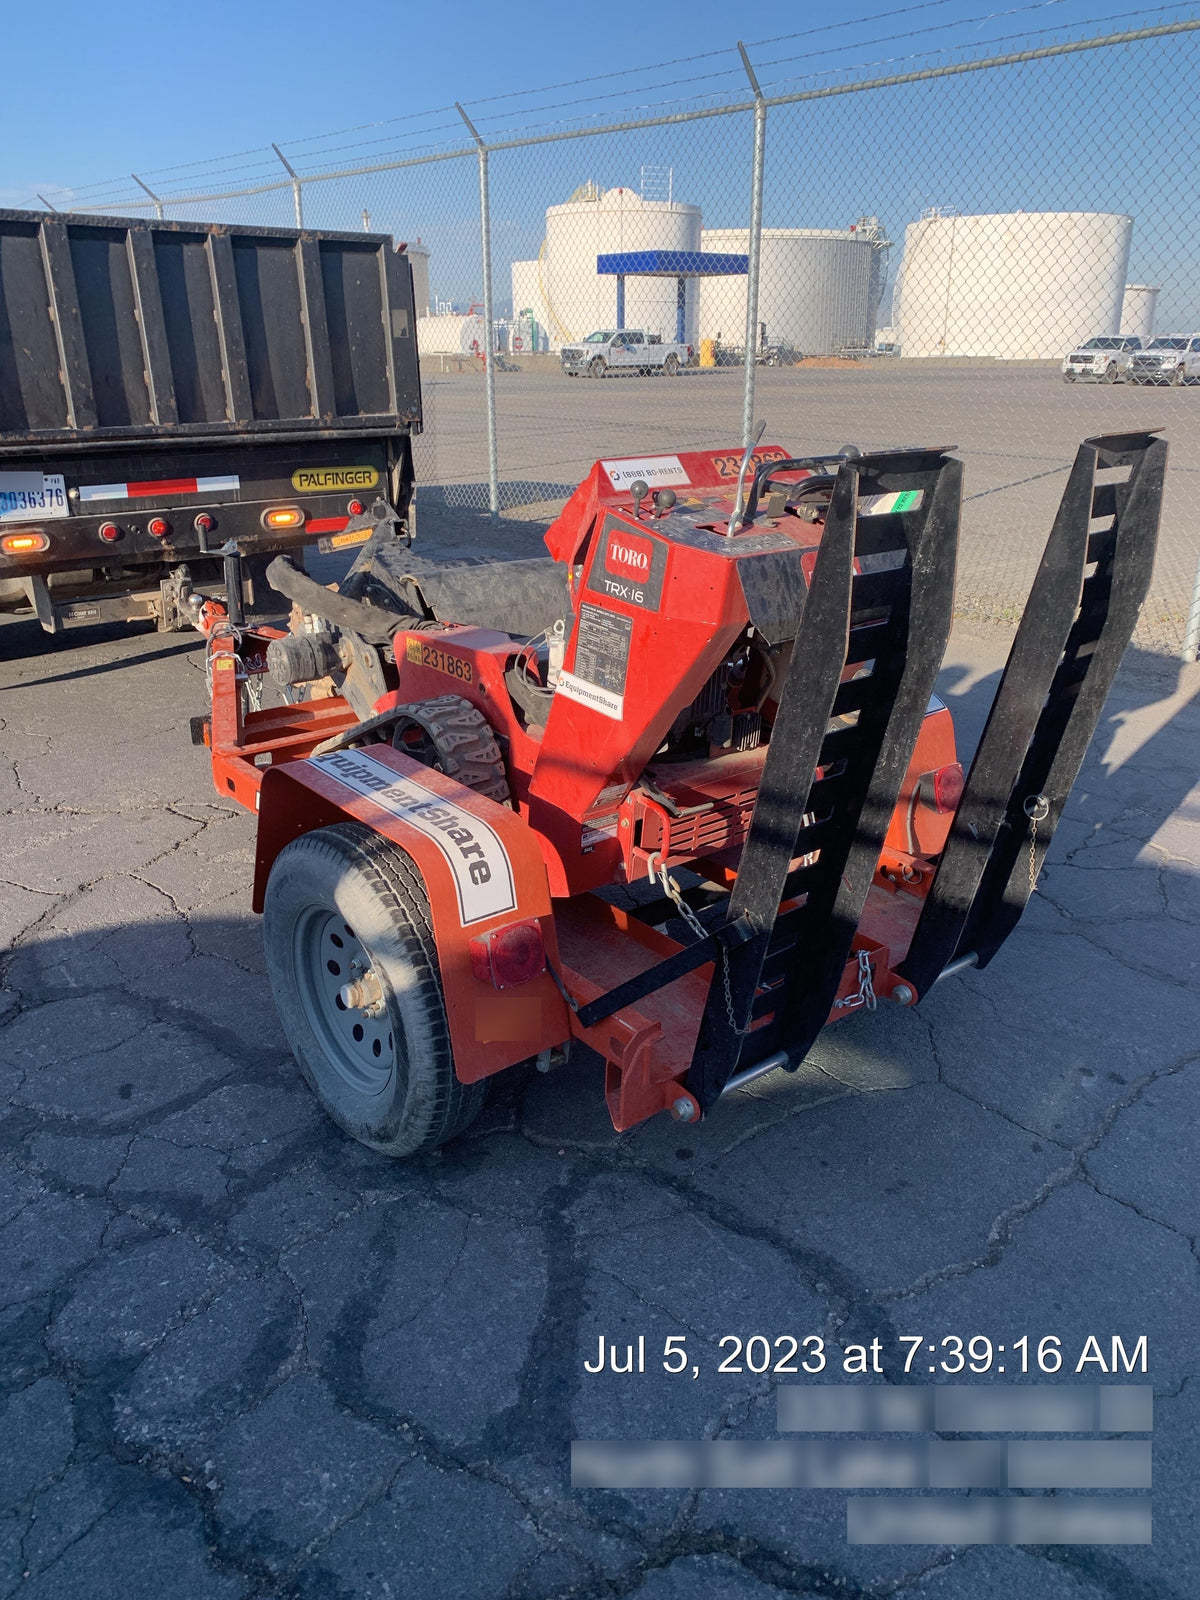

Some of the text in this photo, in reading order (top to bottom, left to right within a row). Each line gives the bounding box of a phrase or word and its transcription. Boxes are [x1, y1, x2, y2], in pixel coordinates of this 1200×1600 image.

[299, 471, 372, 487] PALFINGER
[610, 544, 648, 569] TORO
[423, 646, 472, 682] 231863
[565, 680, 618, 711] EquipmentShare
[315, 753, 492, 886] quipmentShare
